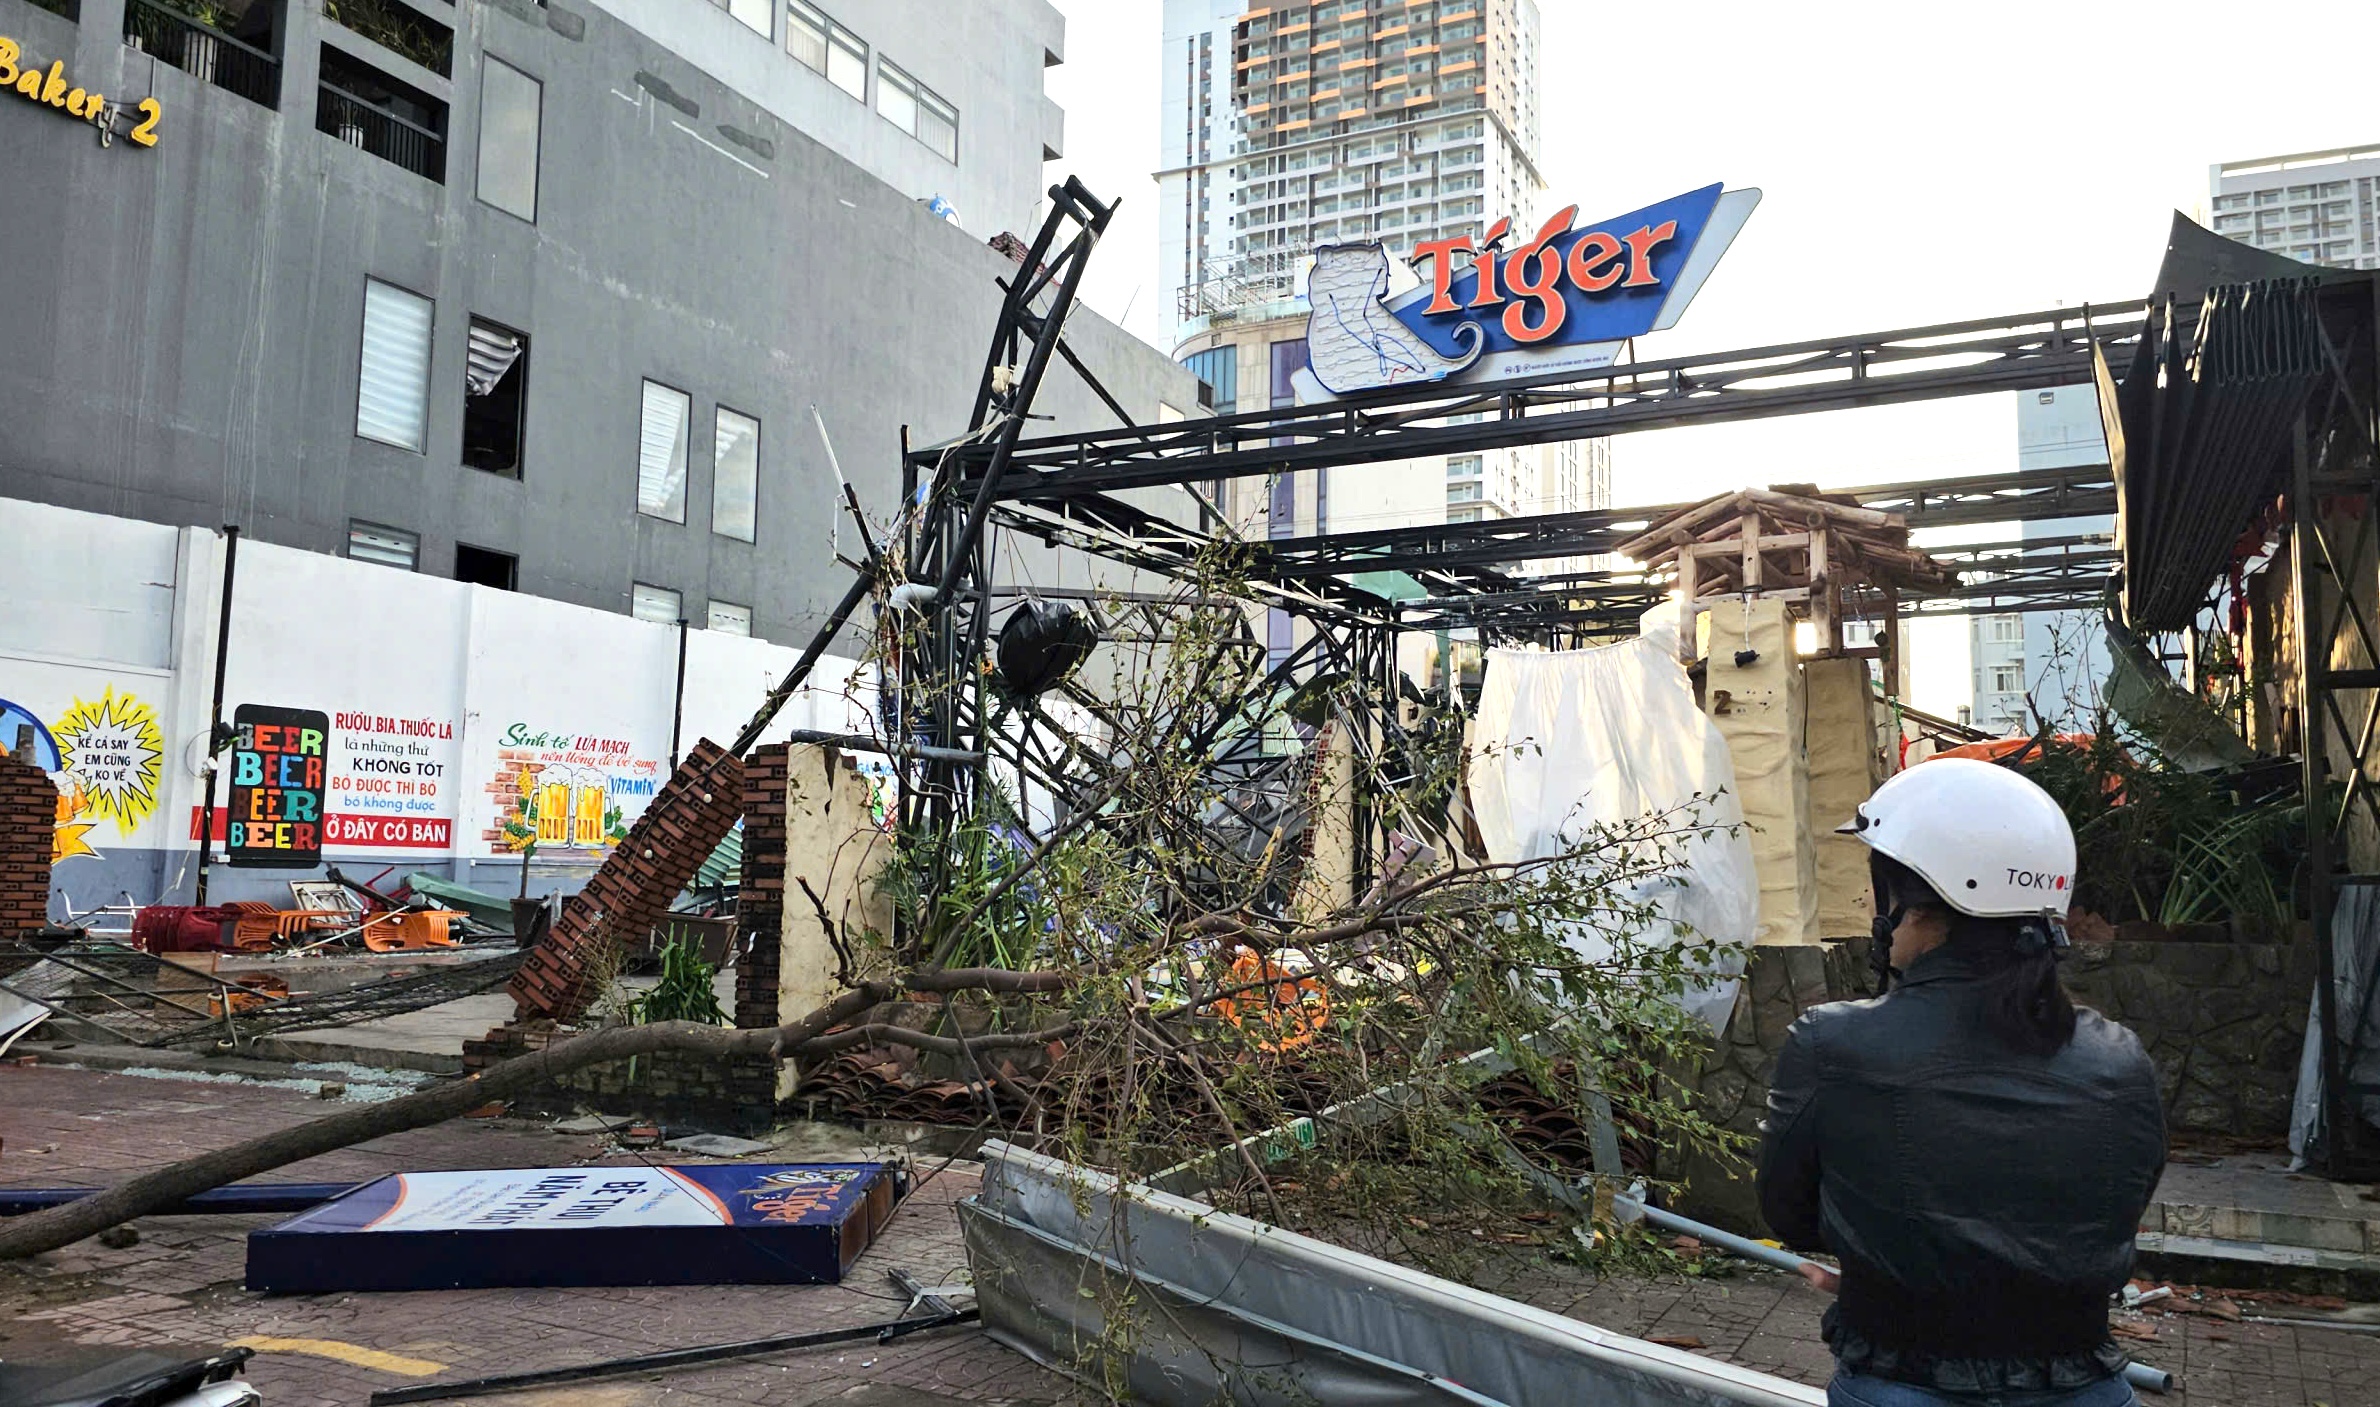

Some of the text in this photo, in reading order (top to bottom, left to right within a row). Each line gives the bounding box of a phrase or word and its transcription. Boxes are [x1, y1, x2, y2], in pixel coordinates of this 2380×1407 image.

[131, 97, 161, 146] 2
[1411, 204, 1678, 342] Tiger
[237, 723, 323, 755] BEER
[439, 720, 452, 739] LÁ
[499, 723, 549, 747] Sinh
[111, 740, 128, 750] SAY
[345, 737, 358, 750] là
[362, 739, 404, 756] những
[85, 753, 131, 766] EM CŨNG
[234, 751, 323, 789] BEER
[353, 757, 444, 777] KHÔNG TỐT
[95, 770, 109, 780] KO
[356, 778, 392, 796] ĐƯỢC
[233, 788, 318, 821] BEER
[364, 796, 403, 812] không
[230, 822, 319, 850] BEER
[326, 814, 446, 842] Ở ĐÂY CÓ BÁN
[549, 1197, 626, 1221] THUI
